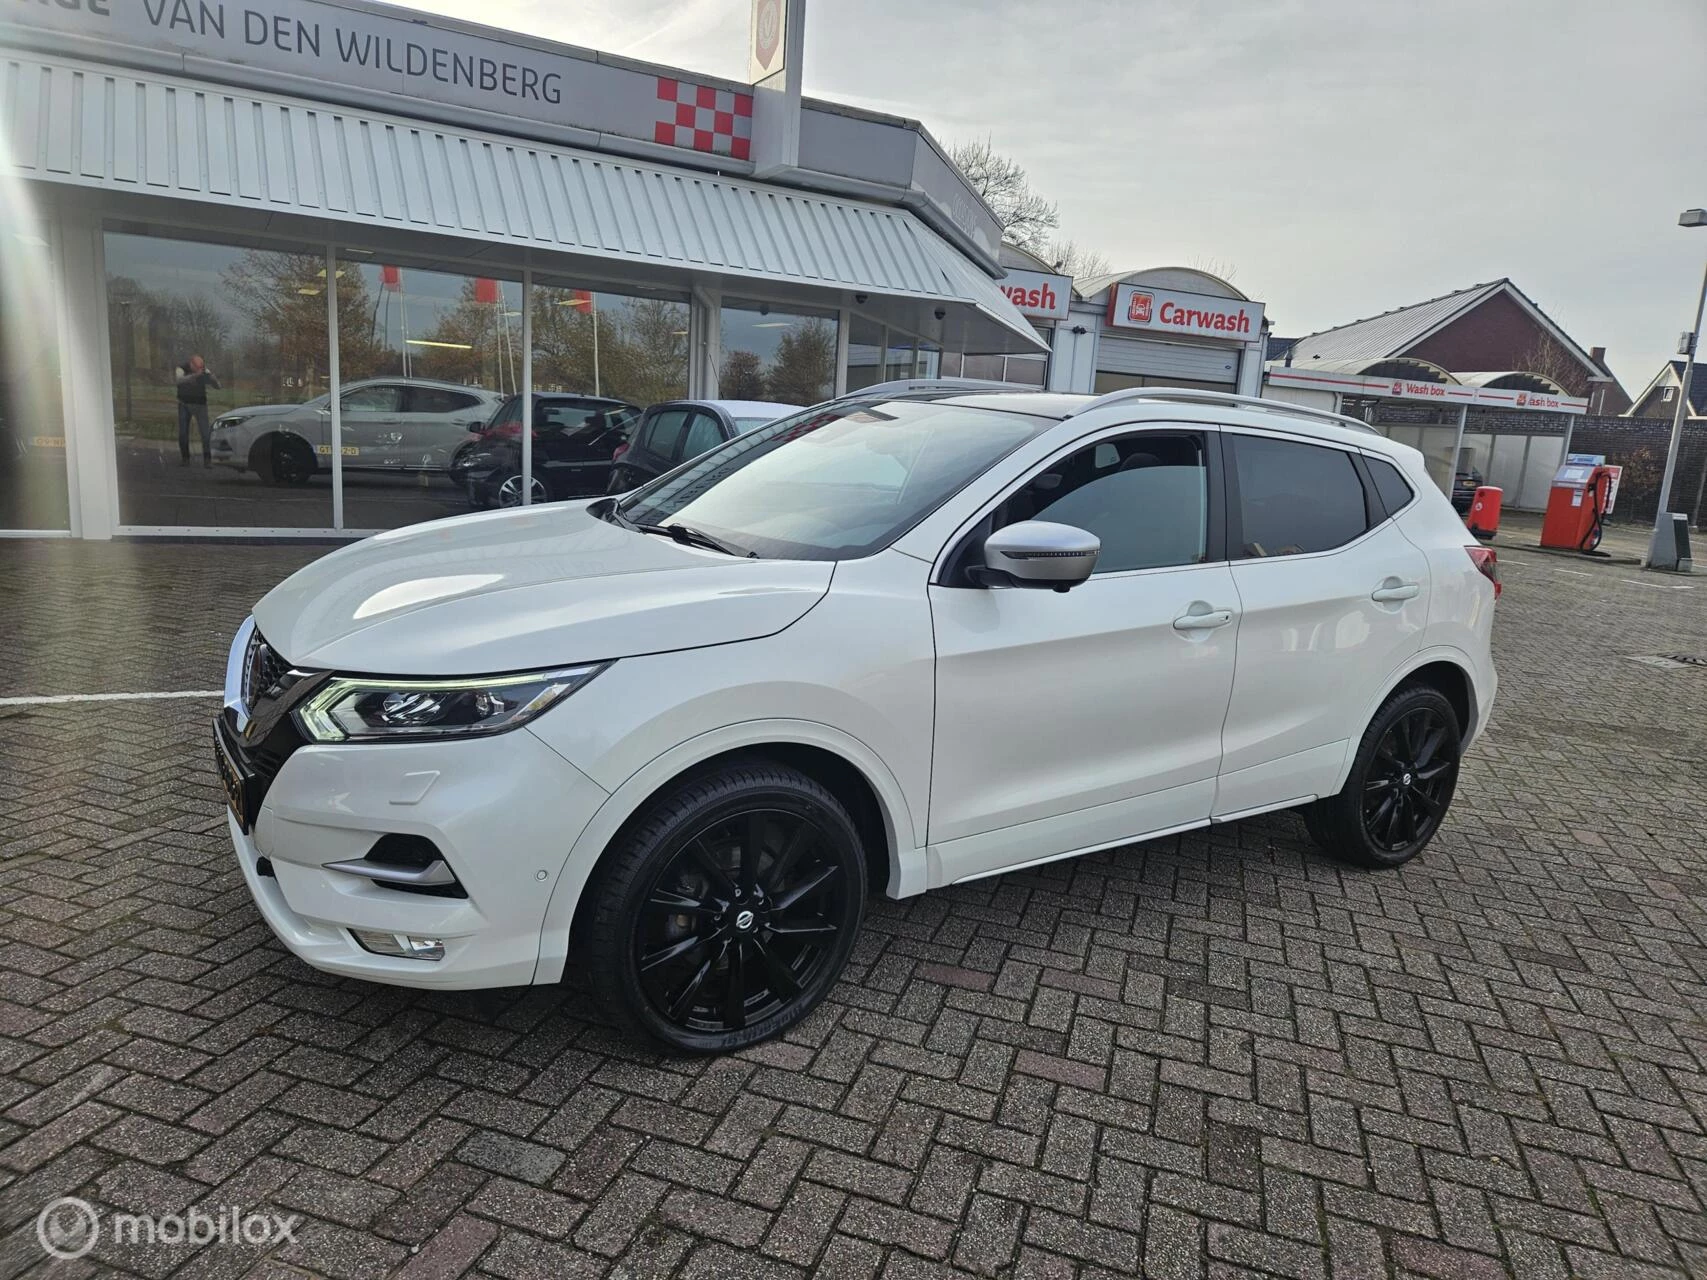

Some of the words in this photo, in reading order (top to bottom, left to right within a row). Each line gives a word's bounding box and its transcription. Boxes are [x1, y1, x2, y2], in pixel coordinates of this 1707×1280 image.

[143, 0, 225, 39] VAN
[244, 9, 320, 57] DEN
[335, 27, 561, 104] WILDENBERG
[1159, 302, 1250, 333] Carwash
[1406, 383, 1429, 395] Wash
[1430, 384, 1446, 396] box
